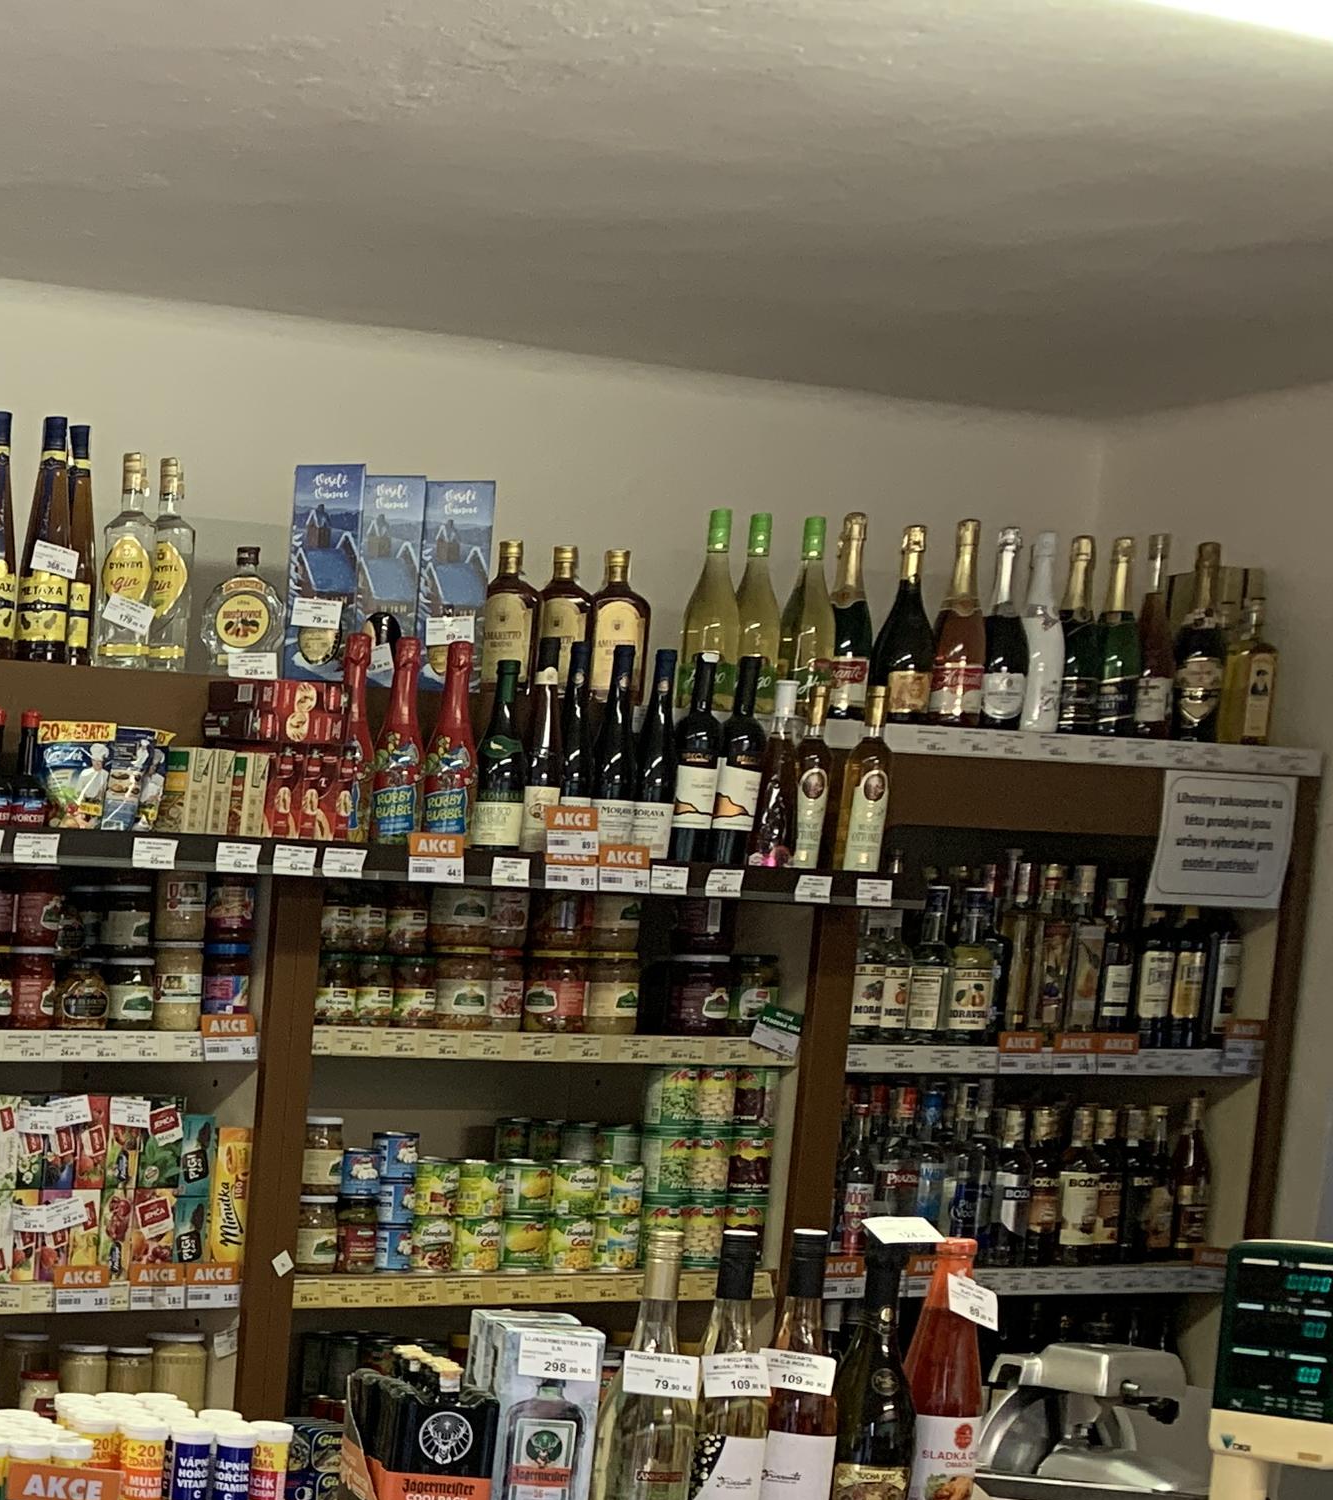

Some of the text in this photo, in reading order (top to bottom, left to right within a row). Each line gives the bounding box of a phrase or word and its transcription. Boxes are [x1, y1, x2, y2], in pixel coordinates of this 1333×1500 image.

[111, 576, 140, 593] Gin
[73, 722, 110, 741] GRATIS
[376, 790, 413, 806] ROBBY
[375, 803, 416, 821] BUBBLE
[220, 1181, 244, 1249] Minutka
[194, 1267, 232, 1281] AKCE
[401, 1476, 475, 1497] Jägermeister
